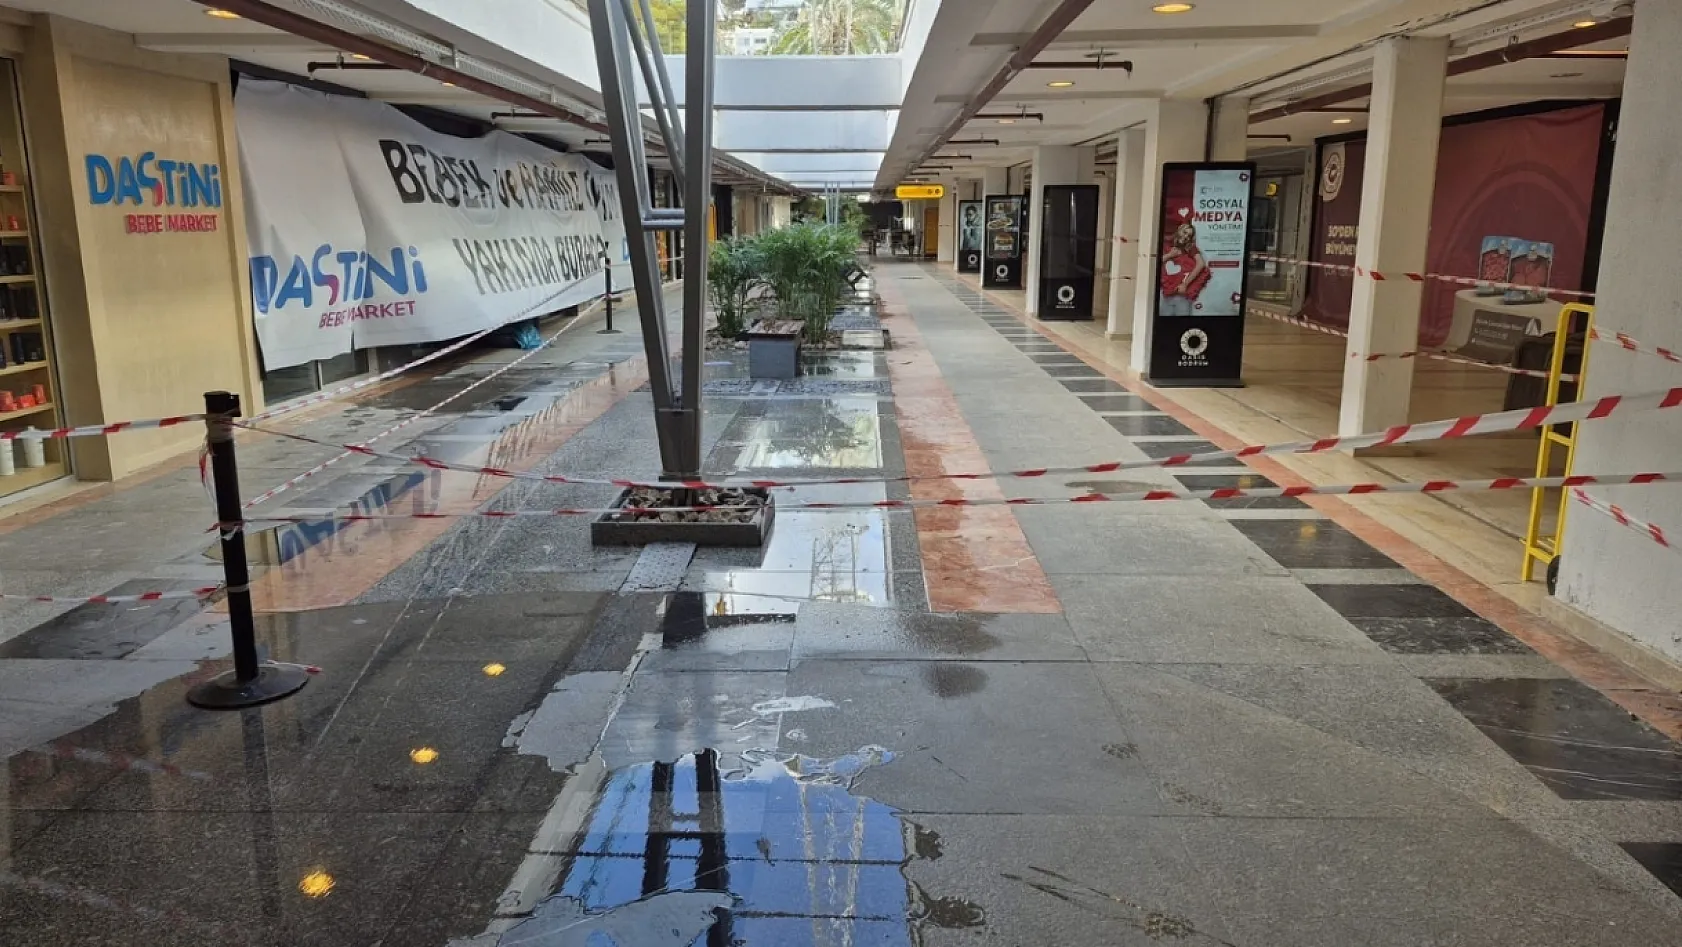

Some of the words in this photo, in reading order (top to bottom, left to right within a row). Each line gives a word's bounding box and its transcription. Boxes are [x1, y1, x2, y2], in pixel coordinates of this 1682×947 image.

[1199, 198, 1244, 209] SOSYAL
[1194, 210, 1243, 221] MEDYA
[126, 214, 163, 233] BEBE
[166, 214, 217, 232] MARKET
[318, 309, 348, 329] BEBE
[347, 300, 415, 323] MARKET
